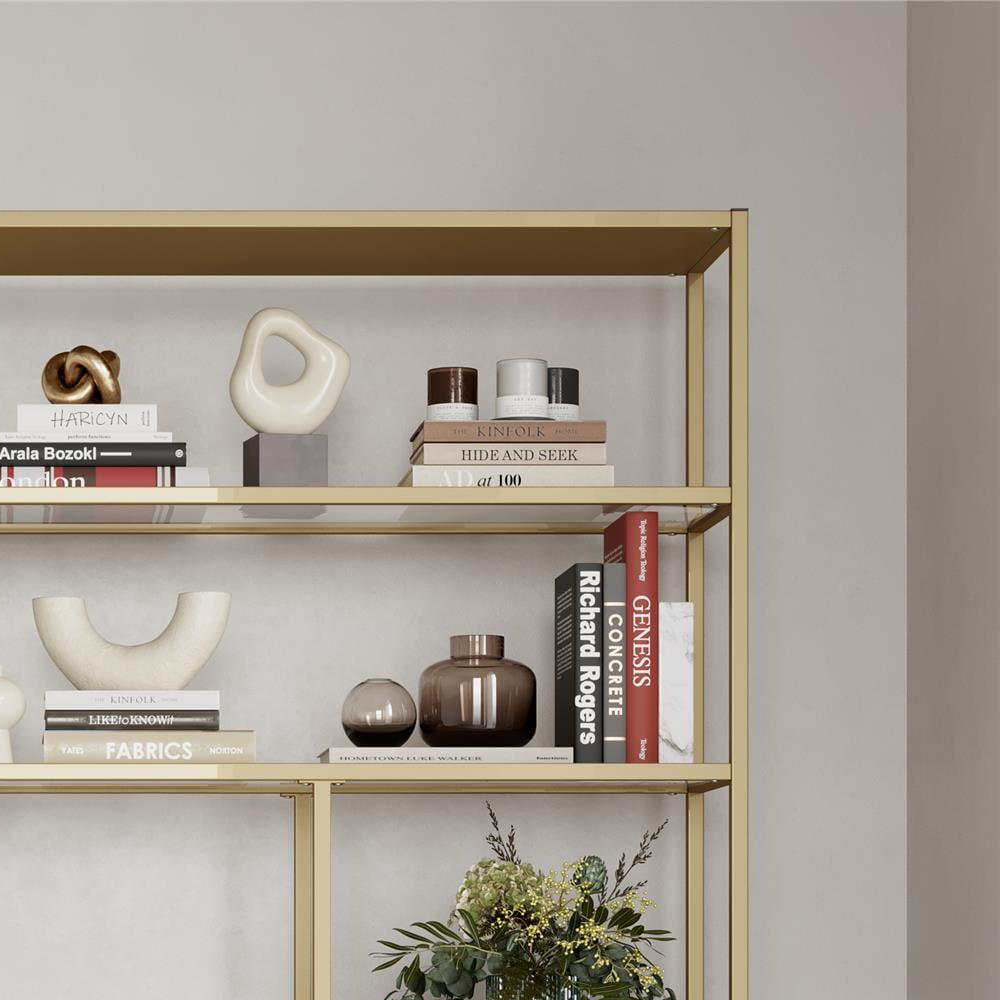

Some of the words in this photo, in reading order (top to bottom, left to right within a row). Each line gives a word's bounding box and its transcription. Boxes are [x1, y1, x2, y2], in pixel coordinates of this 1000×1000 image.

[477, 425, 546, 437] KINFOLK
[461, 449, 499, 461] HIDE
[502, 449, 534, 461] AND
[538, 449, 578, 461] SEEK
[477, 476, 492, 487] at
[499, 474, 522, 487] 100
[579, 570, 600, 658] Richard
[632, 595, 651, 687] GENESIS
[608, 613, 623, 716] CONCRETE
[110, 696, 157, 704] KINFOLK
[575, 665, 600, 745] Rogers
[106, 742, 193, 760] FABRICS
